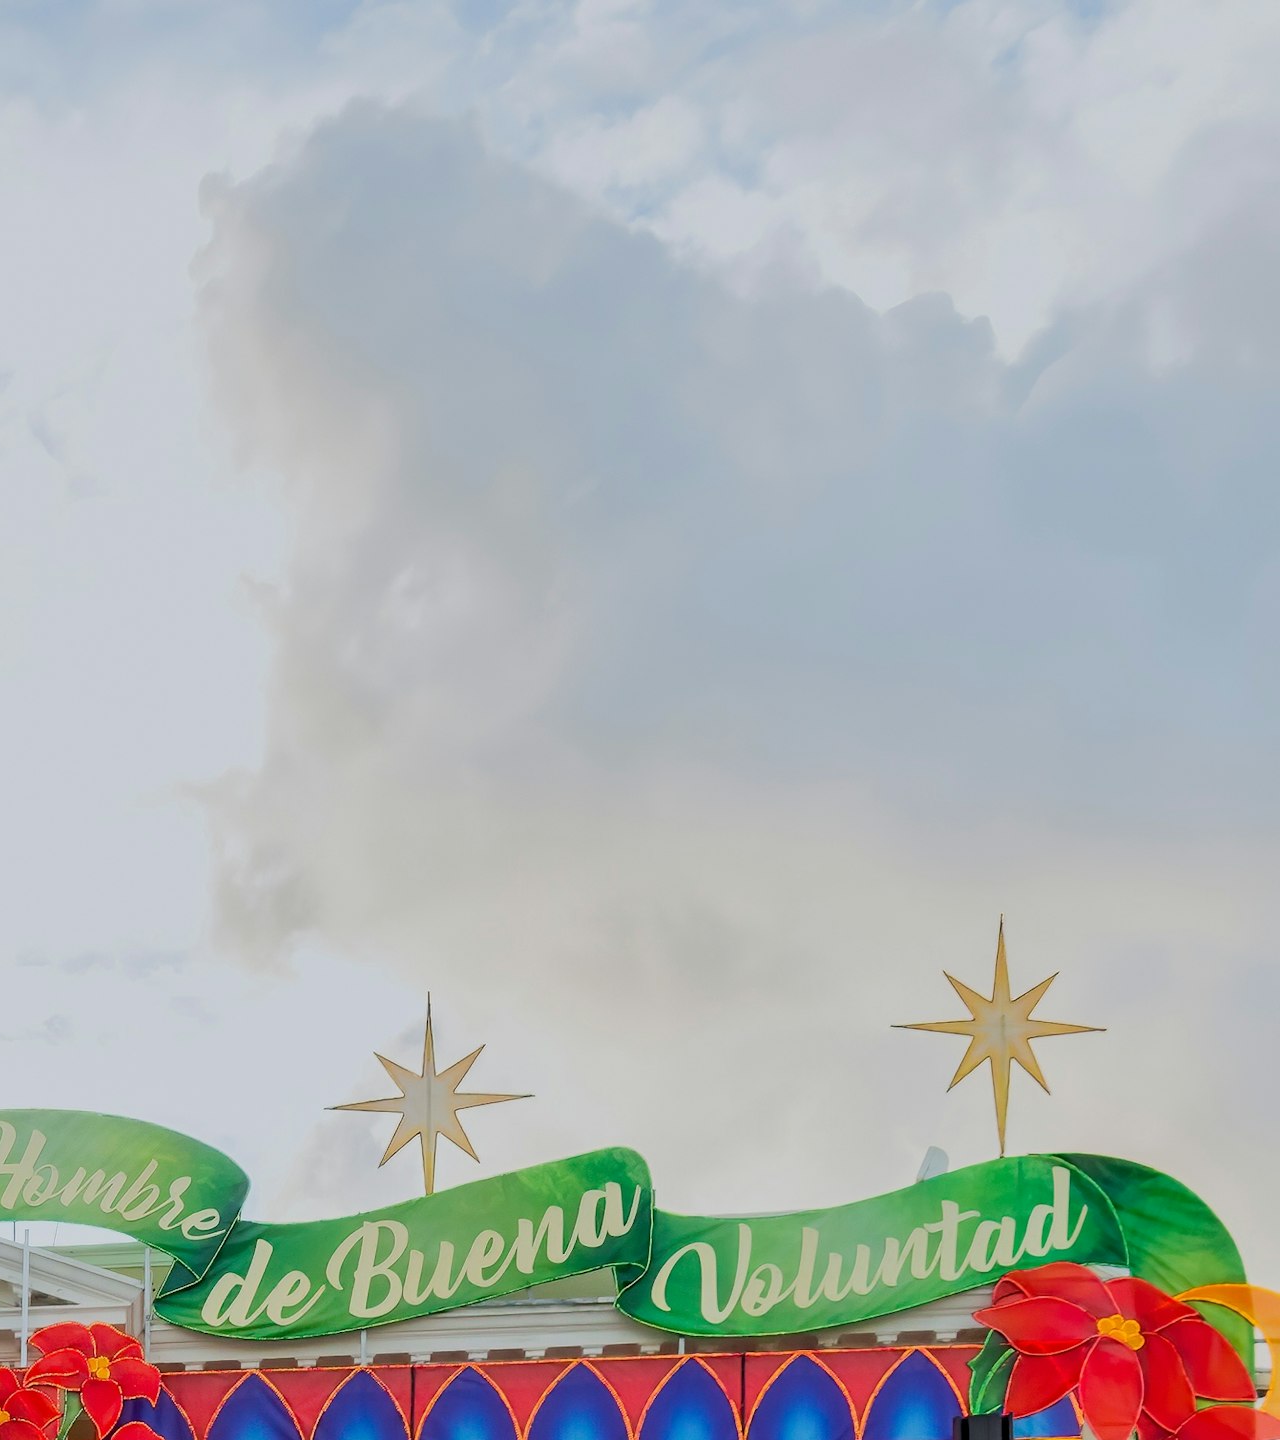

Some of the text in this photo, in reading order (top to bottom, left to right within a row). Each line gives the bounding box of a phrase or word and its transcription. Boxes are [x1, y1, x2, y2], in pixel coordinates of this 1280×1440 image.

[201, 1239, 328, 1327] de
[325, 1182, 641, 1319] Buena
[652, 1165, 1087, 1324] Voluntad
